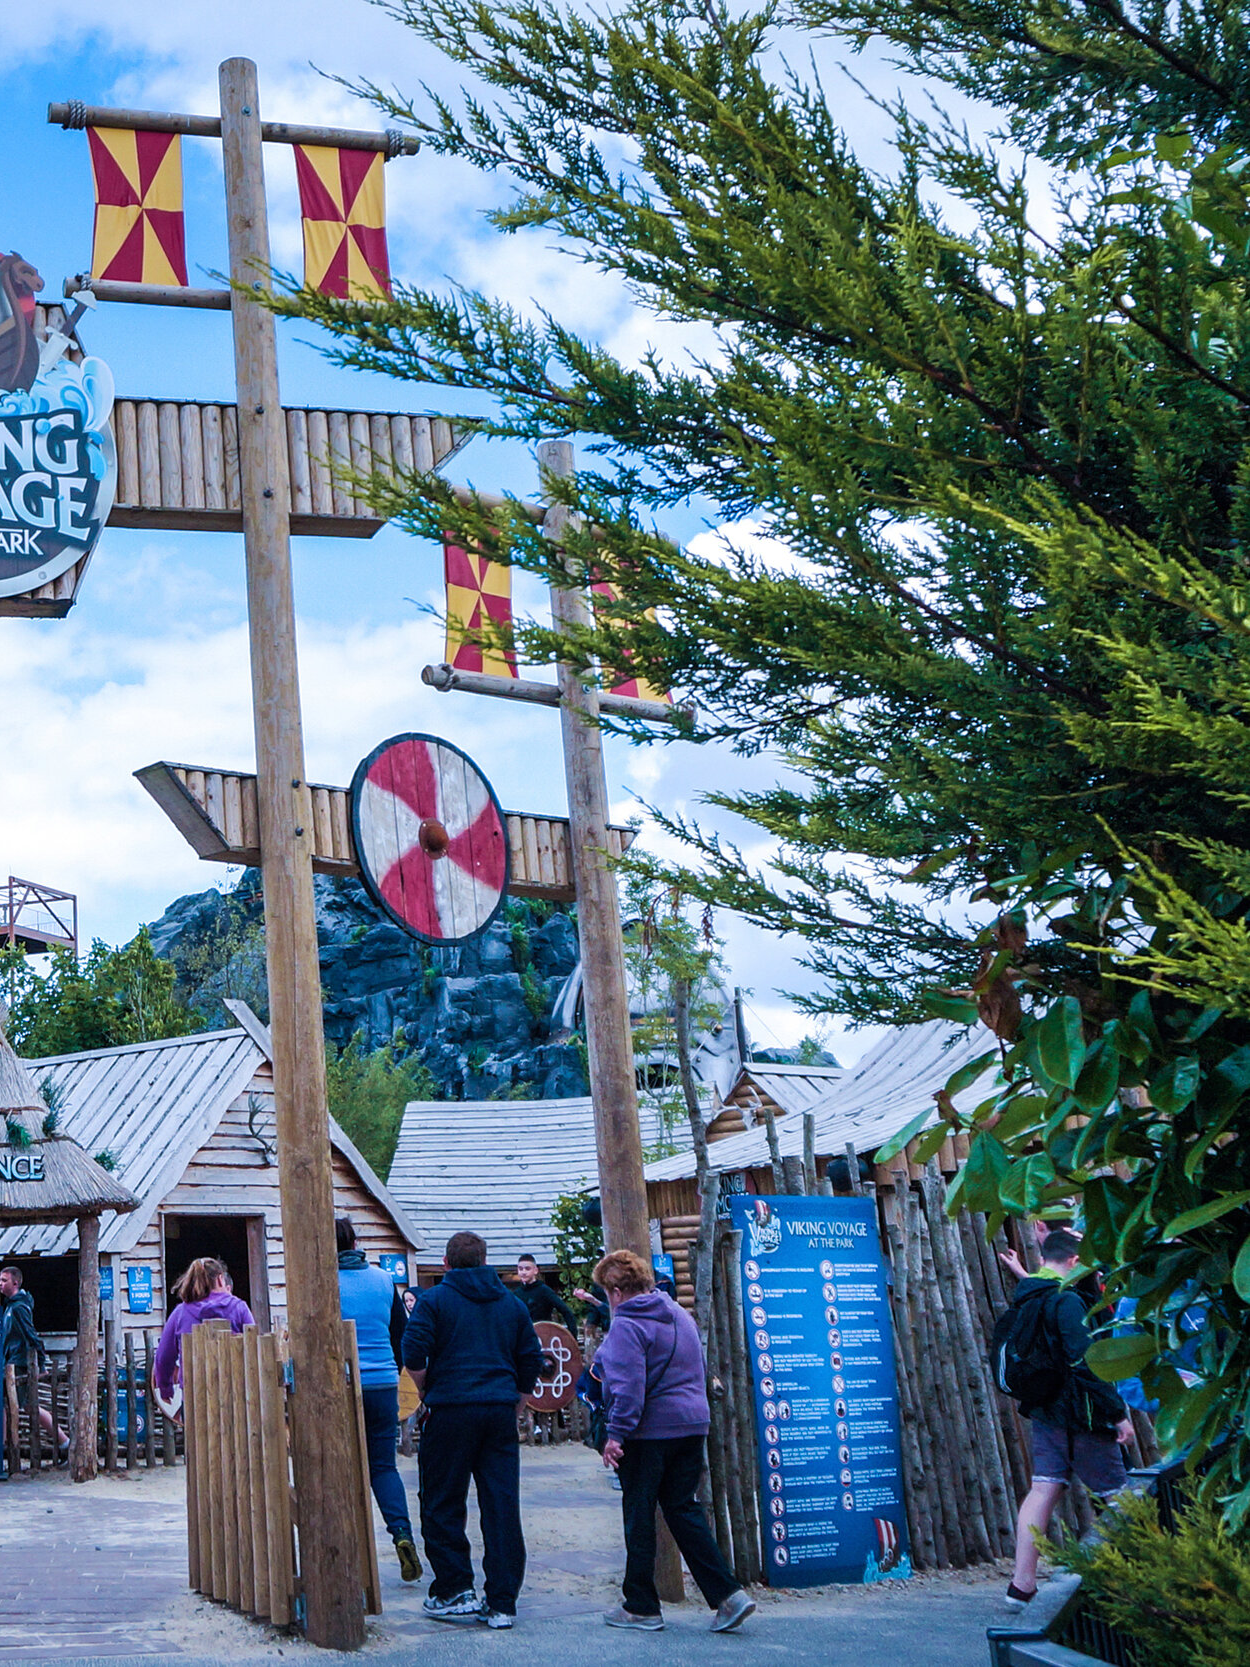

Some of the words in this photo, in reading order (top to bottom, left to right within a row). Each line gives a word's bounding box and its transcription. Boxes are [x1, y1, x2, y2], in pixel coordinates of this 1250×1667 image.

[786, 1221, 826, 1236] VIKING
[827, 1222, 868, 1237] VOYAGE
[808, 1238, 818, 1248] AT
[820, 1238, 835, 1248] THE
[836, 1239, 854, 1249] PARK
